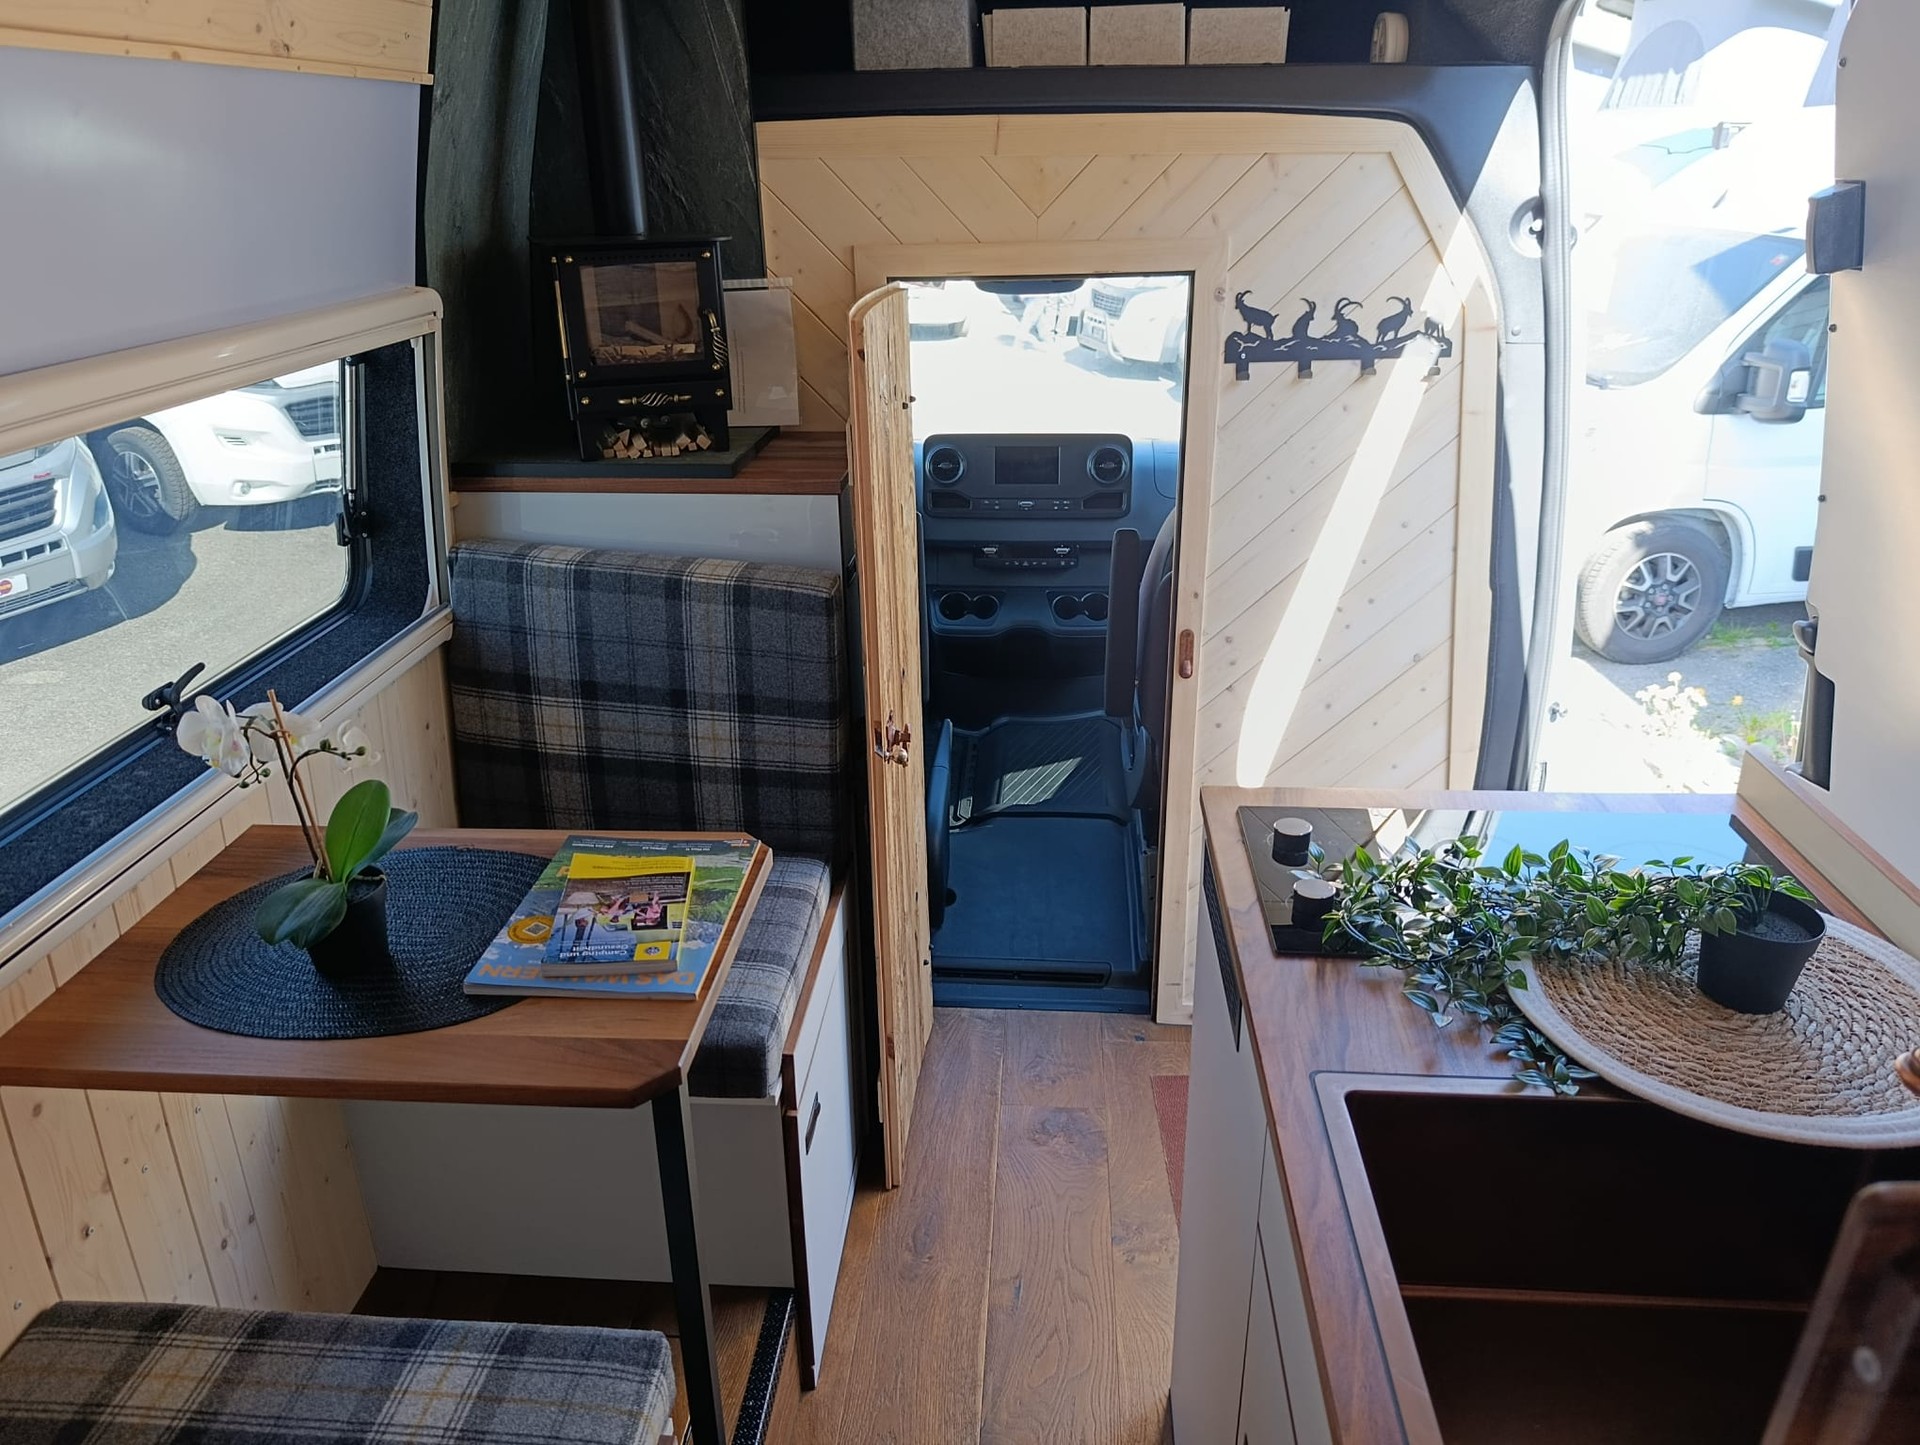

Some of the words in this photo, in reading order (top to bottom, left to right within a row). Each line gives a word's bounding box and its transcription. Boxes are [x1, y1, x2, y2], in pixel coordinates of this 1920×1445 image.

[572, 944, 629, 952] Gesundheit
[581, 949, 627, 957] Camping
[636, 971, 696, 985] DAS
